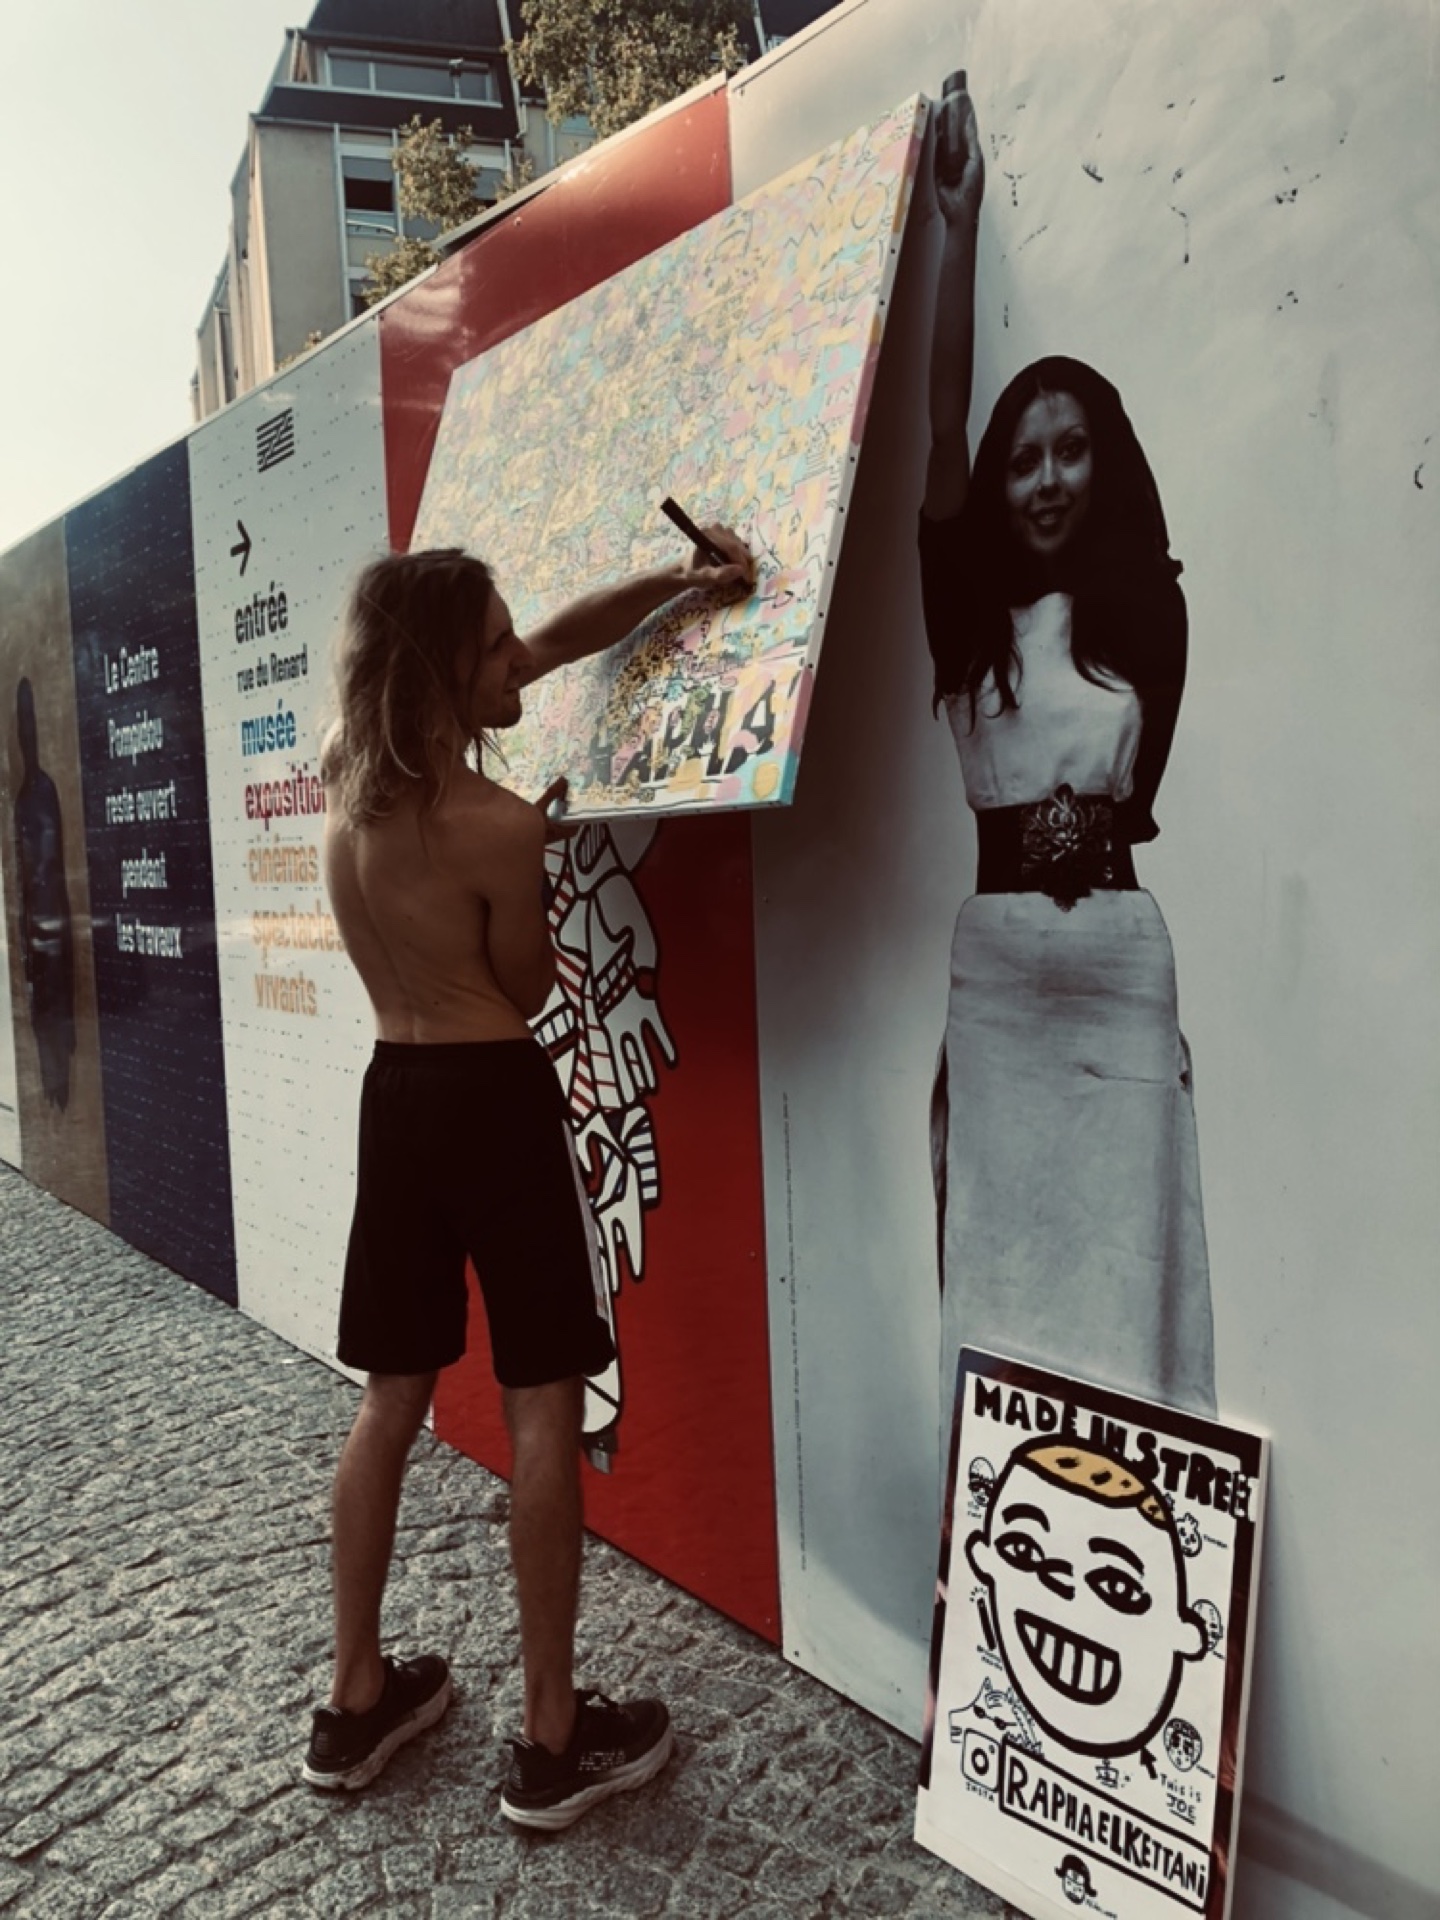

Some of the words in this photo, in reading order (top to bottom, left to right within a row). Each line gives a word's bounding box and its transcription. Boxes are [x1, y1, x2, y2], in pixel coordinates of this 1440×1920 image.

[235, 580, 288, 644] entrée
[104, 653, 118, 693] Le
[120, 645, 159, 688] Centre
[237, 665, 254, 693] rue
[257, 657, 268, 688] du
[270, 643, 308, 684] Renard
[107, 710, 164, 766] Pompidou
[241, 699, 296, 757] musée
[105, 786, 135, 825] reste
[136, 779, 178, 821] ouvert
[121, 848, 168, 899] pendant
[249, 833, 319, 884] cinémas
[116, 913, 135, 952] les
[135, 918, 183, 959] travaux
[254, 970, 318, 1016] vivants
[973, 1376, 1078, 1438] MADE
[1167, 1793, 1197, 1820] JOE
